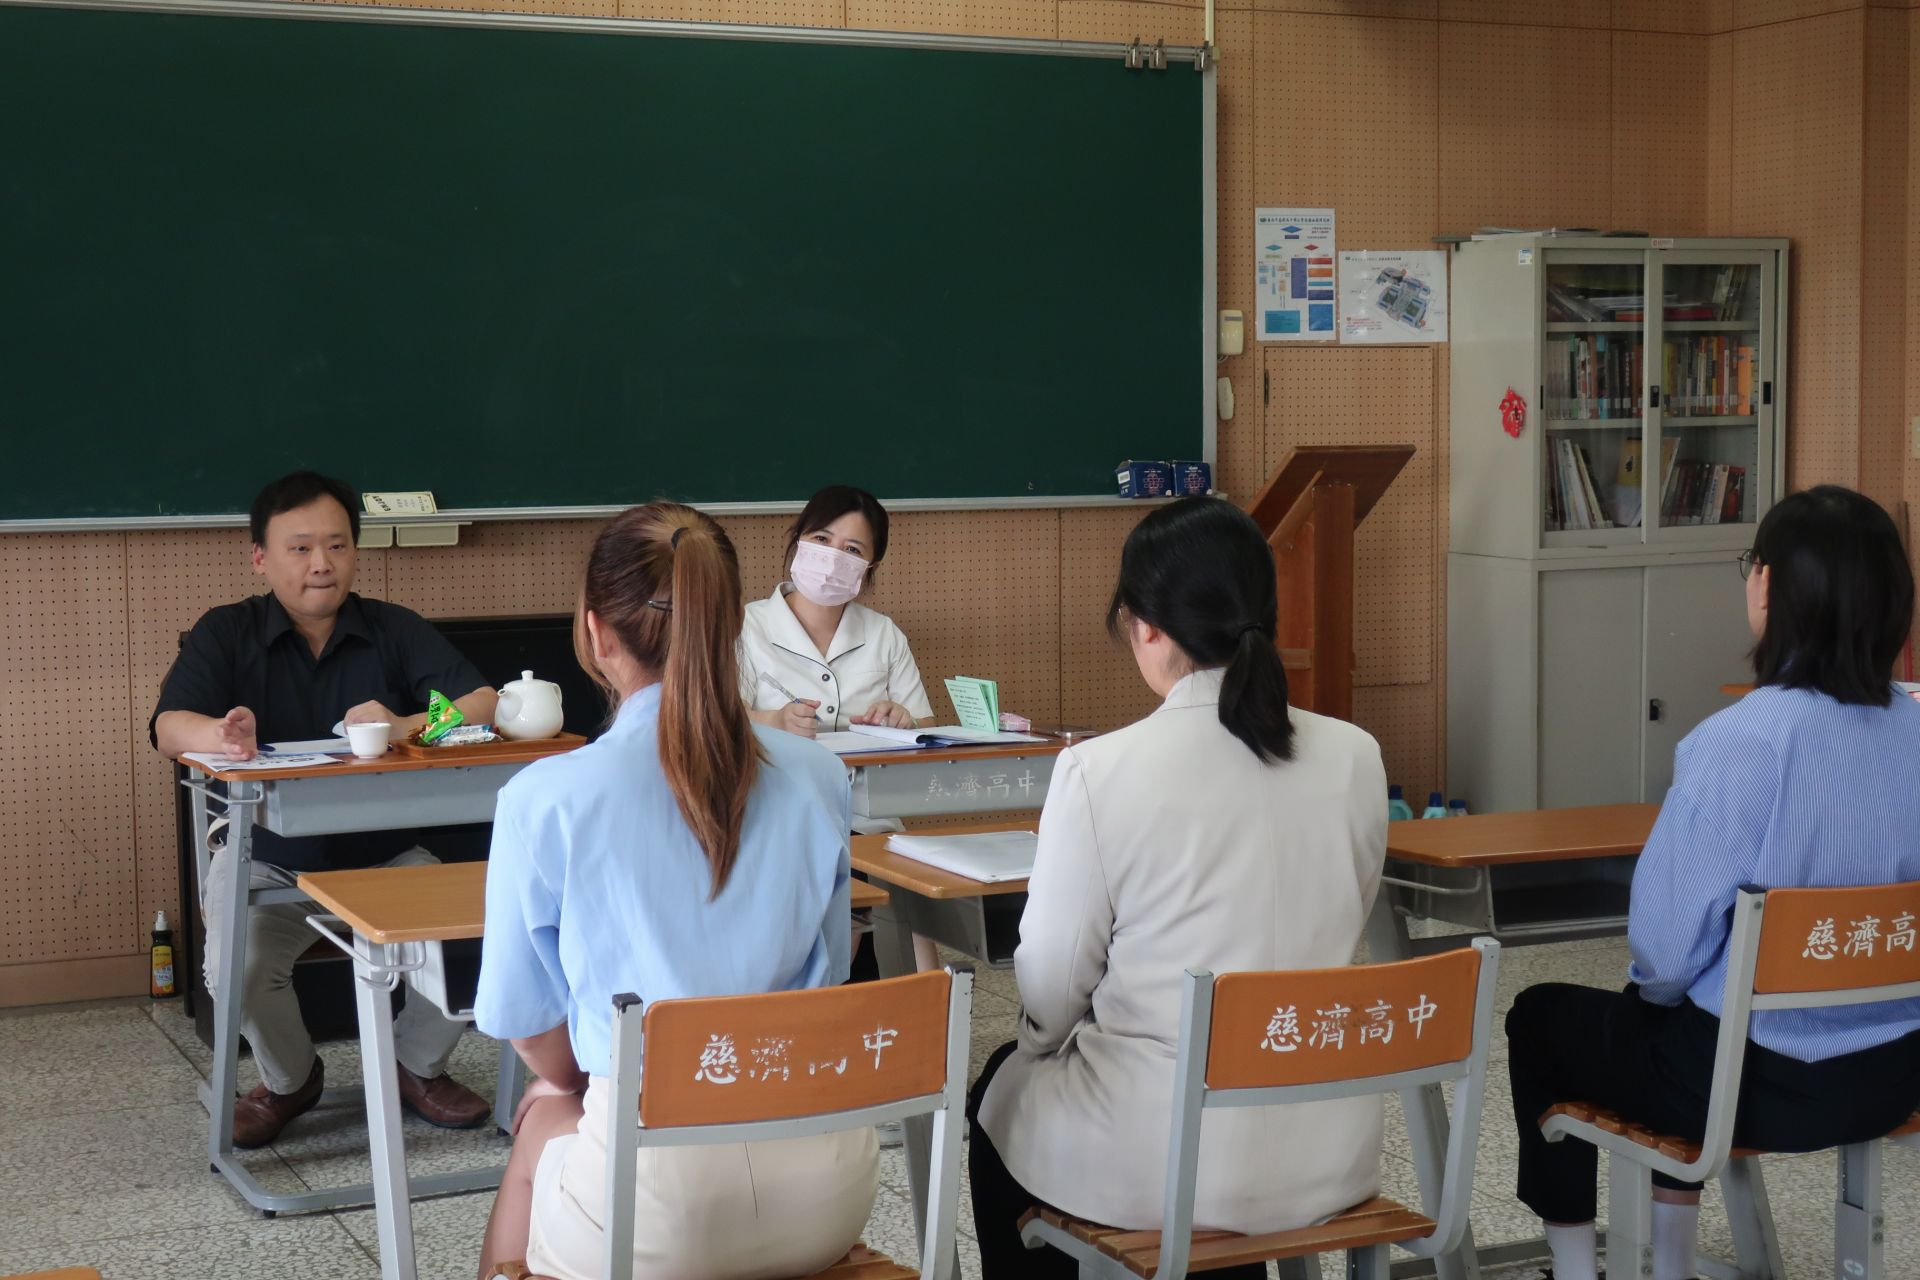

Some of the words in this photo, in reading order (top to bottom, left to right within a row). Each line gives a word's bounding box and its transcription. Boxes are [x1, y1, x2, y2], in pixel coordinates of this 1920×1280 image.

[1802, 911, 1917, 960] 慈濟高
[1260, 994, 1438, 1052] 慈濟高中
[695, 1024, 898, 1084] 慈濟中
